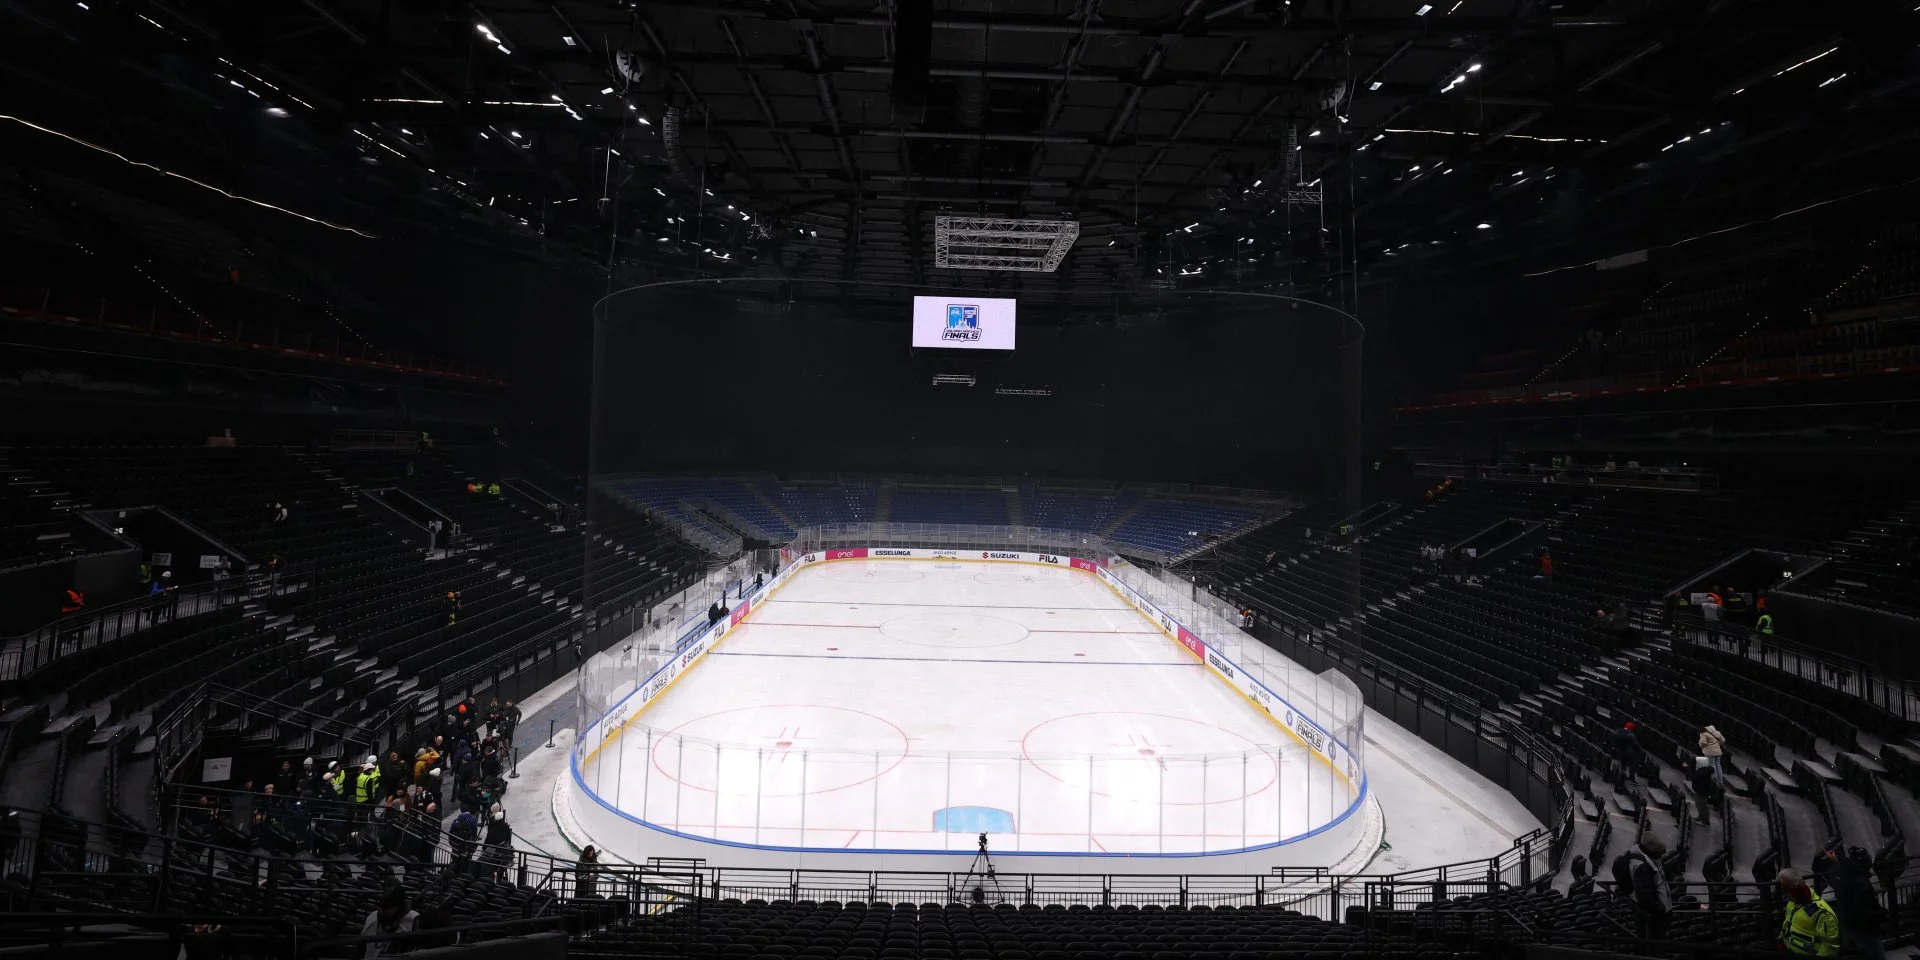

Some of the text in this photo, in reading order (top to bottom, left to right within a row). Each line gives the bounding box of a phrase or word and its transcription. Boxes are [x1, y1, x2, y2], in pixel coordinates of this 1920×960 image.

[804, 553, 816, 564] FILA
[837, 550, 854, 558] enel
[990, 552, 1020, 560] SUZUKI
[1038, 554, 1059, 564] FILA
[1161, 616, 1172, 632] FILA
[713, 623, 725, 642] FILA
[1185, 635, 1196, 650] enel
[687, 641, 705, 662] SUZUKI
[1209, 653, 1234, 680] ESSELUNGA
[1297, 723, 1322, 749] FINALS
